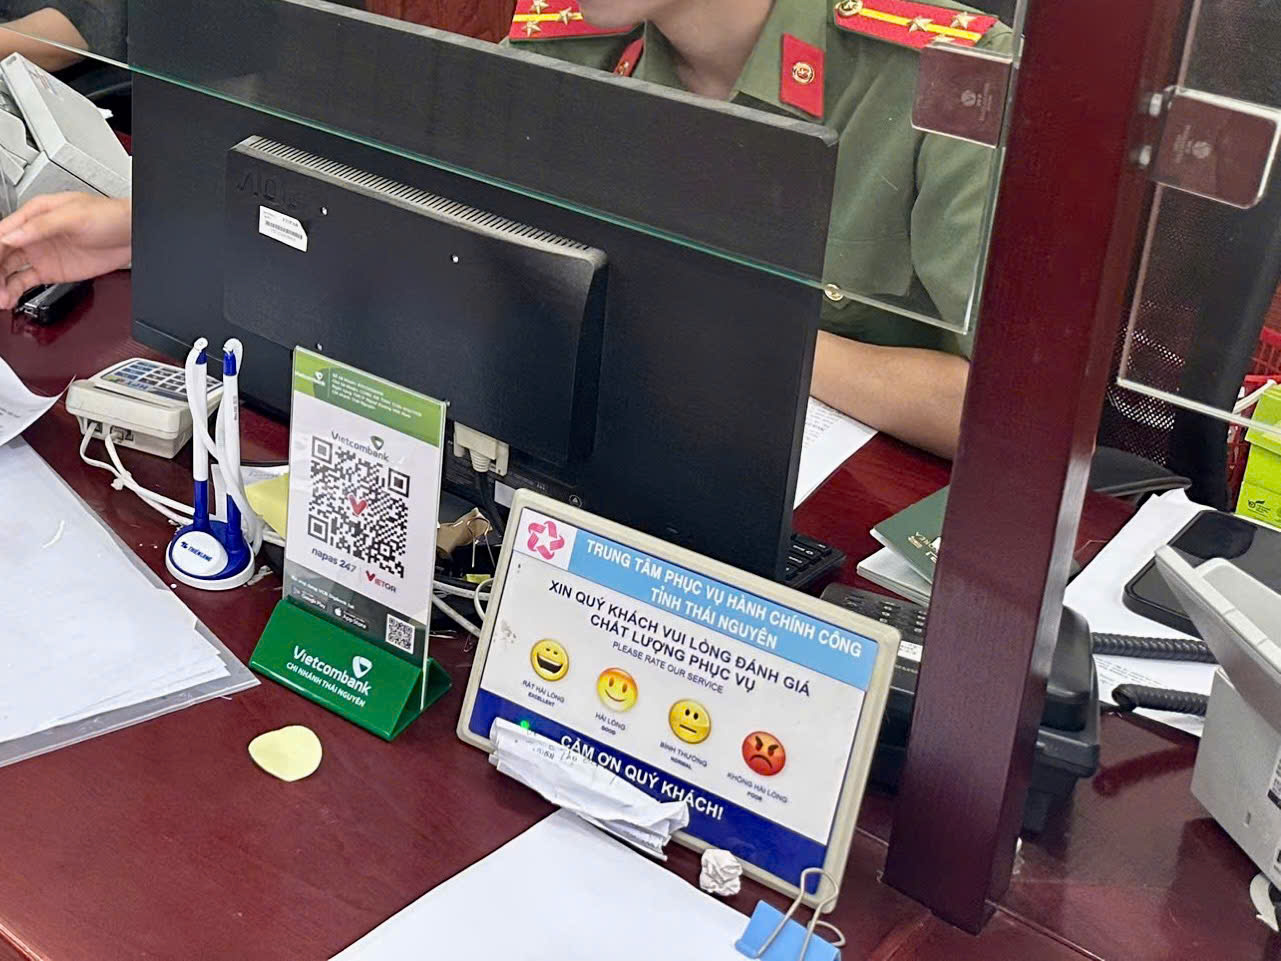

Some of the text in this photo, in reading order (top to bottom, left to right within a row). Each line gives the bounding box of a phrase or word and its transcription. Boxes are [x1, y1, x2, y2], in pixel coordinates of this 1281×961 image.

[331, 431, 389, 462] Vietcombank
[312, 546, 357, 573] napas 247
[585, 539, 631, 569] TRUNG
[632, 555, 663, 580] TÂM
[663, 569, 702, 598] PHỤC
[702, 584, 724, 607] VỤ
[725, 590, 767, 621] HÀNH
[768, 605, 816, 640] CHÍNH
[817, 623, 863, 657] CÔNG
[649, 584, 778, 649] TỈNH THÁI NGUYÊN
[548, 579, 812, 697] XIN QUÝ KHÁCH VUI LÒNG ĐÁNH GIÁ
[589, 610, 756, 694] CHẤT LƯỢNG PHỤC VỤ
[612, 640, 723, 694] PLEASE RATE OUR SERVICE
[287, 662, 365, 707] CHI NHÁNH THÁI NGUYÊN
[294, 646, 372, 696] Vietcombank
[561, 735, 594, 760] CẢM
[598, 752, 622, 773] ƠN
[625, 764, 659, 789] QUÝ
[661, 781, 724, 820] KHÁCH!
